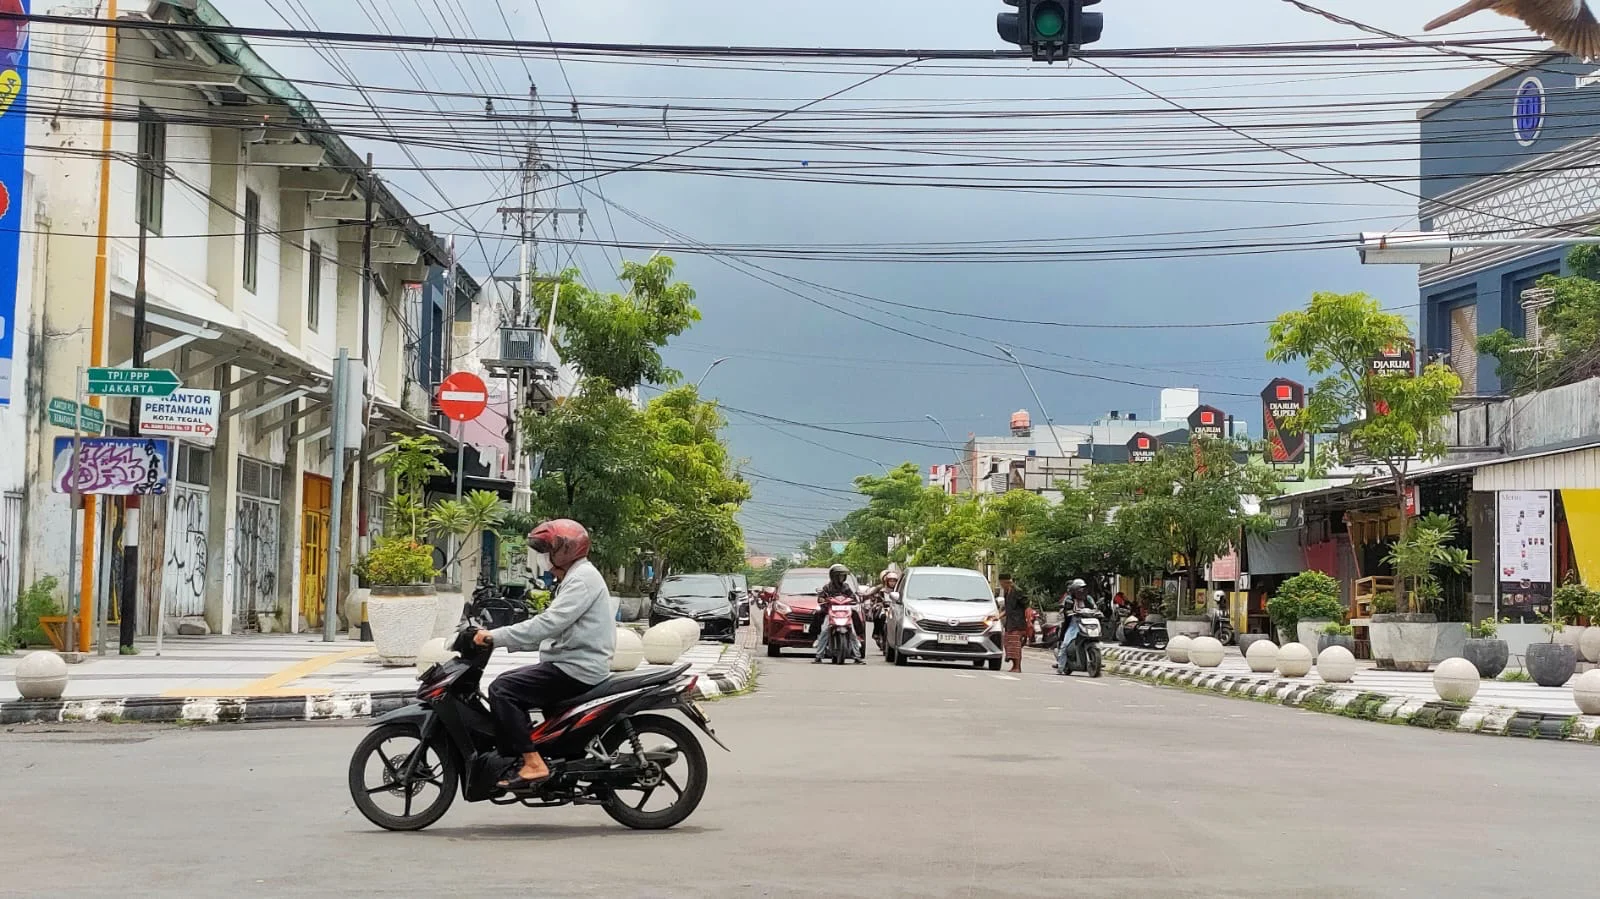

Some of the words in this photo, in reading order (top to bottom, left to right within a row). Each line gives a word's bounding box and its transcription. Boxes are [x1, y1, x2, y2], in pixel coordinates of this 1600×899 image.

[107, 371, 123, 380] TPI
[130, 372, 150, 381] PPP
[102, 384, 154, 393] JAKARTA
[145, 403, 212, 416] PERTANAHAN
[177, 416, 203, 424] TEGAL
